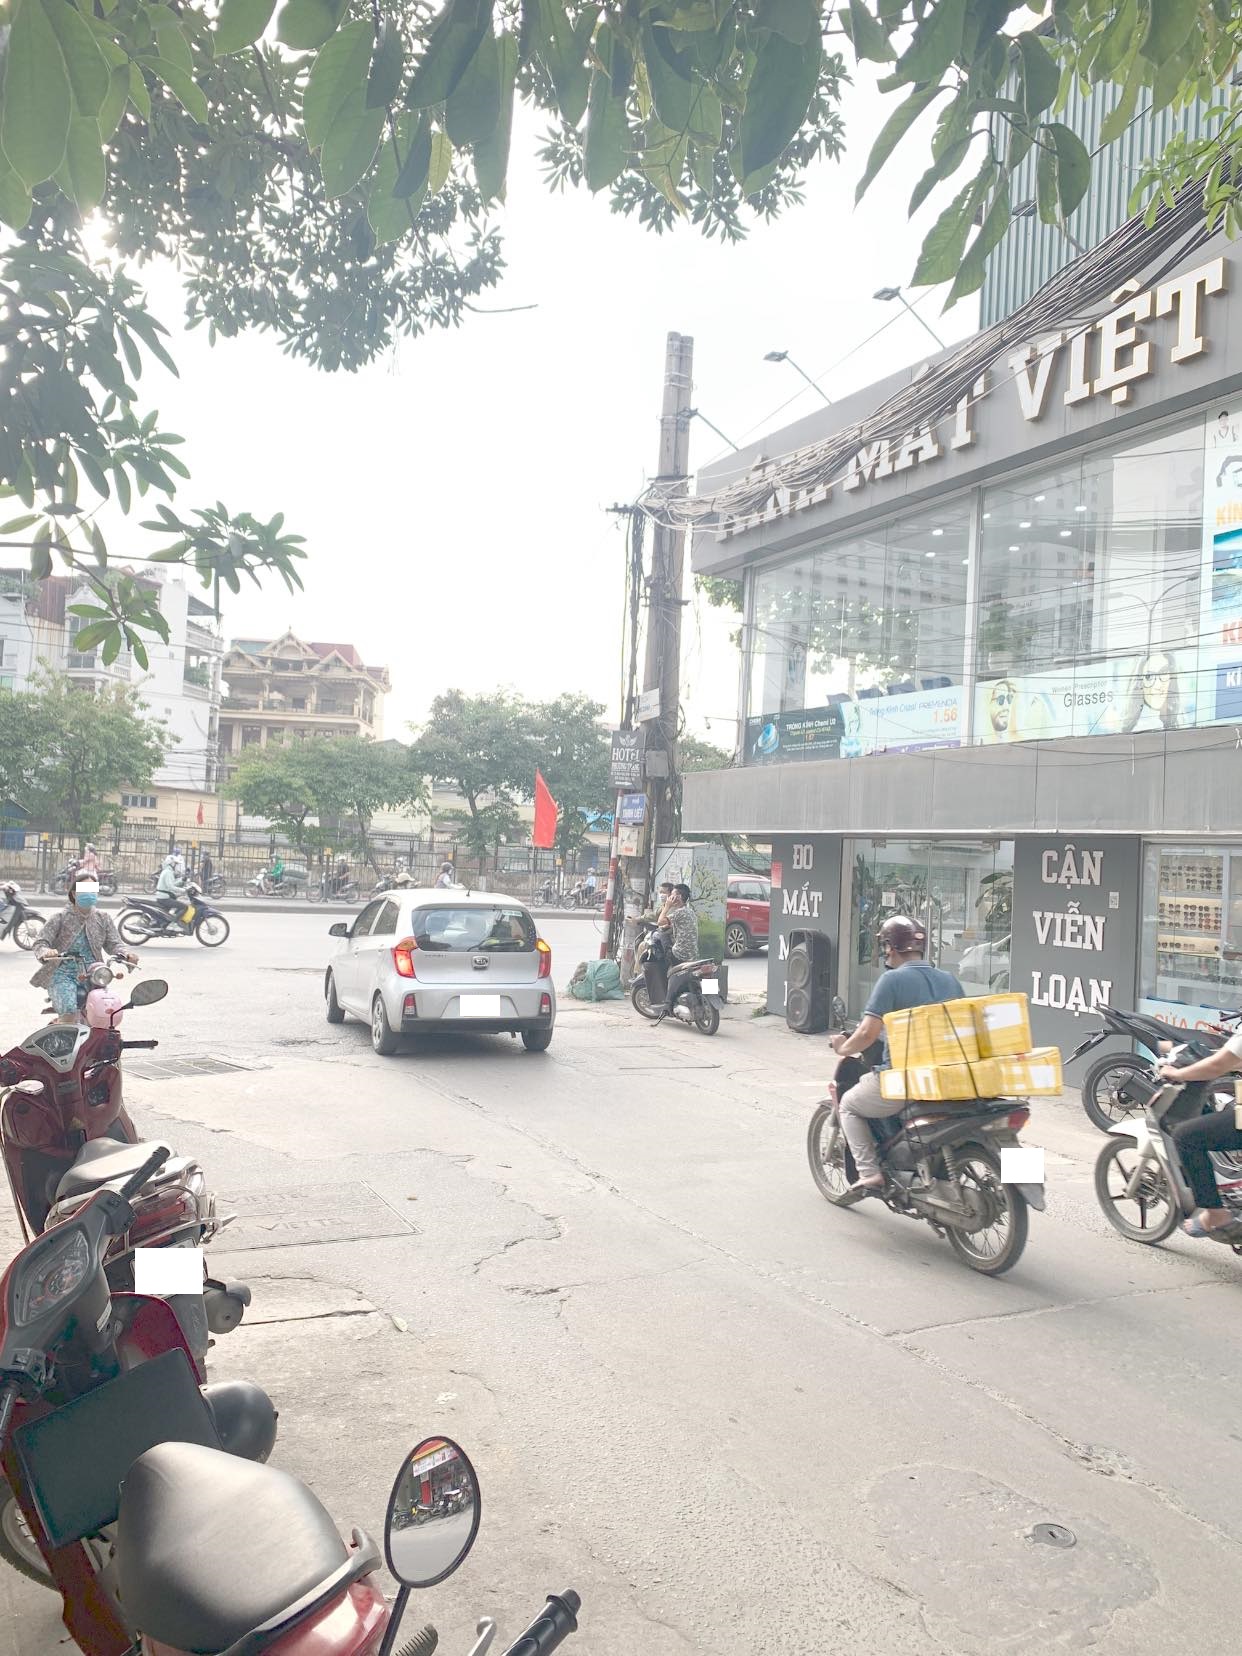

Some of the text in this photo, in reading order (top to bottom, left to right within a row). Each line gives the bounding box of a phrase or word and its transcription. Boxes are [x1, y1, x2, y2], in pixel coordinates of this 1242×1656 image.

[1008, 257, 1226, 421] VIỆT
[933, 706, 957, 724] 1.56
[1063, 690, 1113, 708] Glasses
[612, 747, 640, 762] HOTEL
[792, 844, 814, 870] ĐO
[1042, 844, 1104, 889] CẬN
[782, 880, 823, 918] MẮT
[1032, 900, 1106, 951] VIỄN
[1031, 970, 1112, 1017] LOẠN
